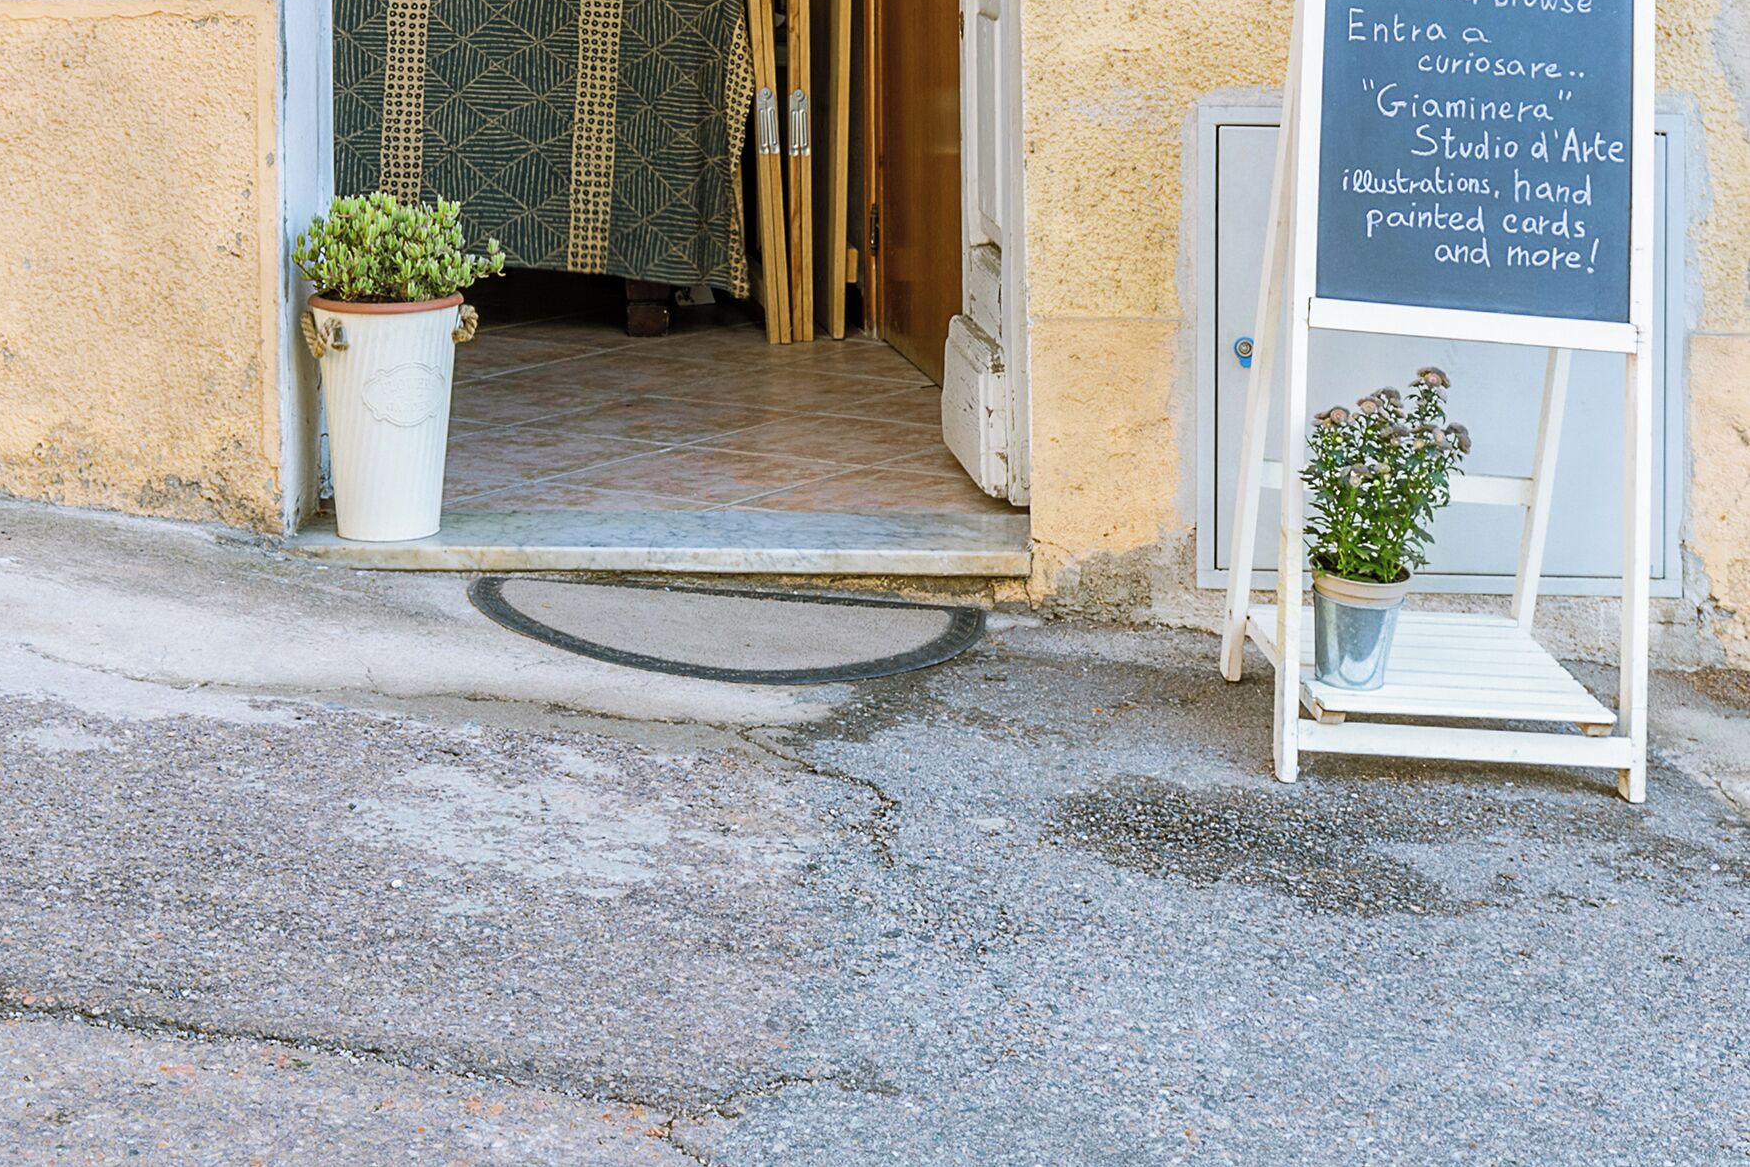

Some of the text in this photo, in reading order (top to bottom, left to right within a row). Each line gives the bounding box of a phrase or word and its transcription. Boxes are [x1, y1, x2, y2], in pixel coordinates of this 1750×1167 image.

[1349, 8, 1491, 43] Entra a
[1362, 79, 1572, 122] "Giaminera"
[1411, 124, 1625, 163] Studio d'Arte
[1342, 166, 1592, 206] illustrations, hand
[1366, 202, 1586, 238] painted cards
[1435, 238, 1599, 274] and more!
